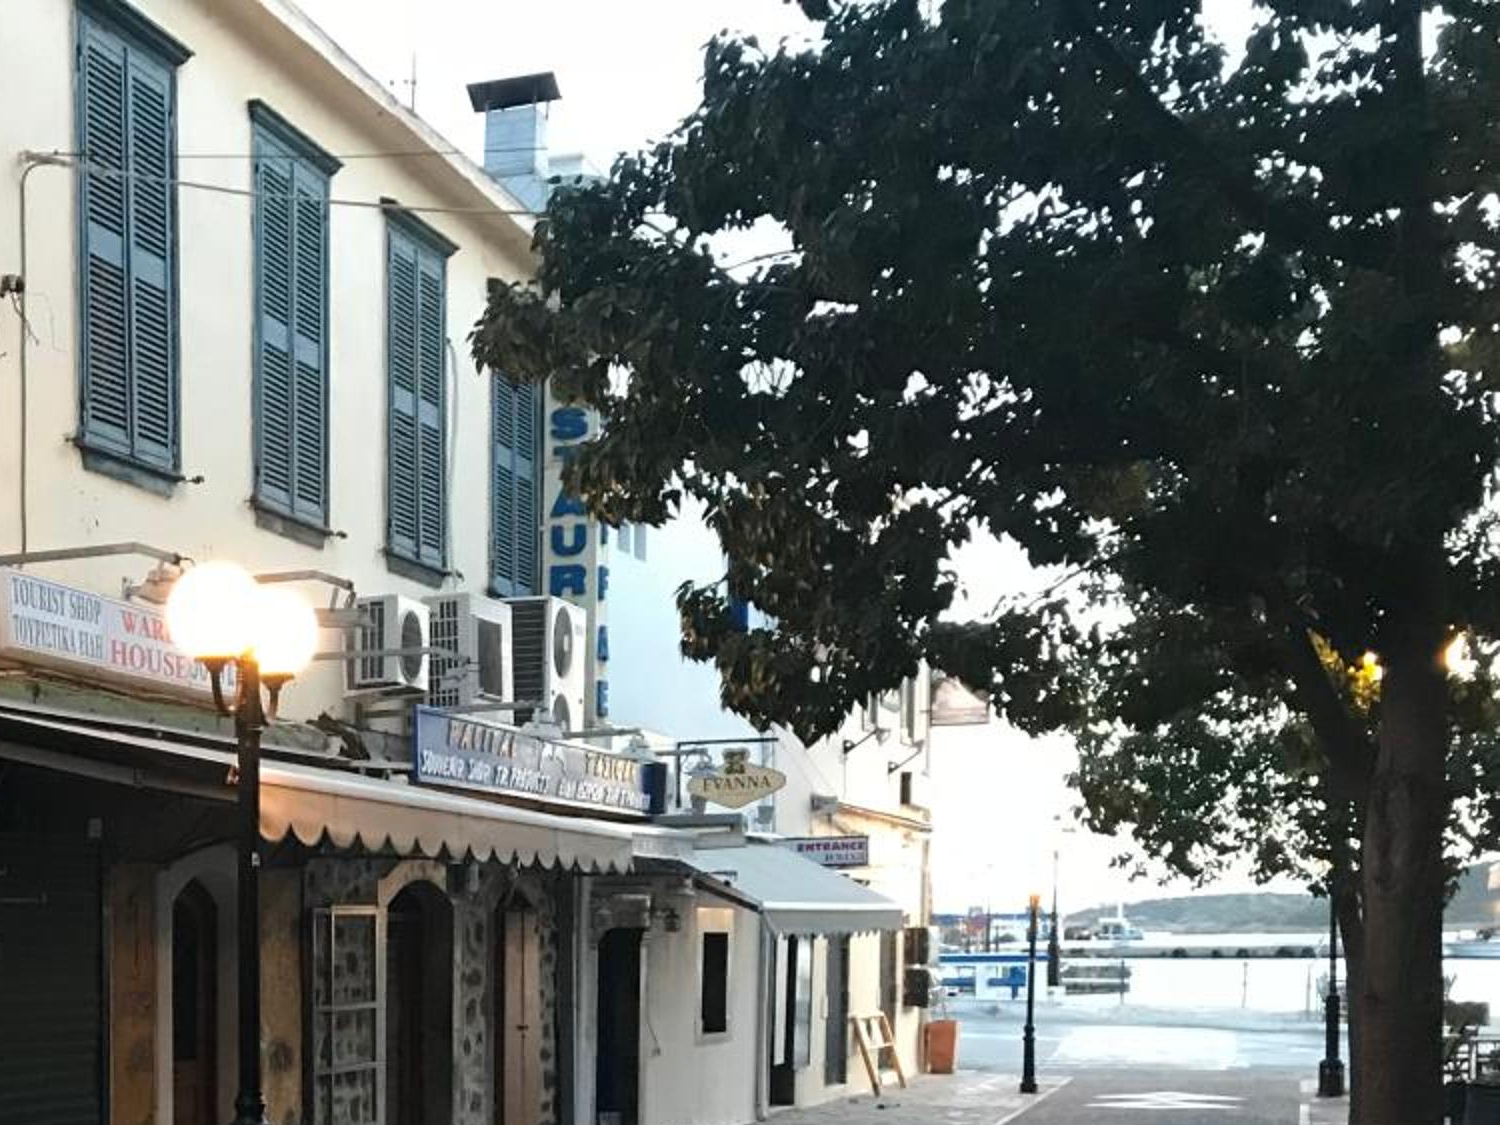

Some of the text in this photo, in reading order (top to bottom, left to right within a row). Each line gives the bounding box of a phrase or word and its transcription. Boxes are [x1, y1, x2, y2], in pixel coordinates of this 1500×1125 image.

[12, 577, 101, 625] TOURIST SHOP
[111, 639, 188, 680] HOUSE
